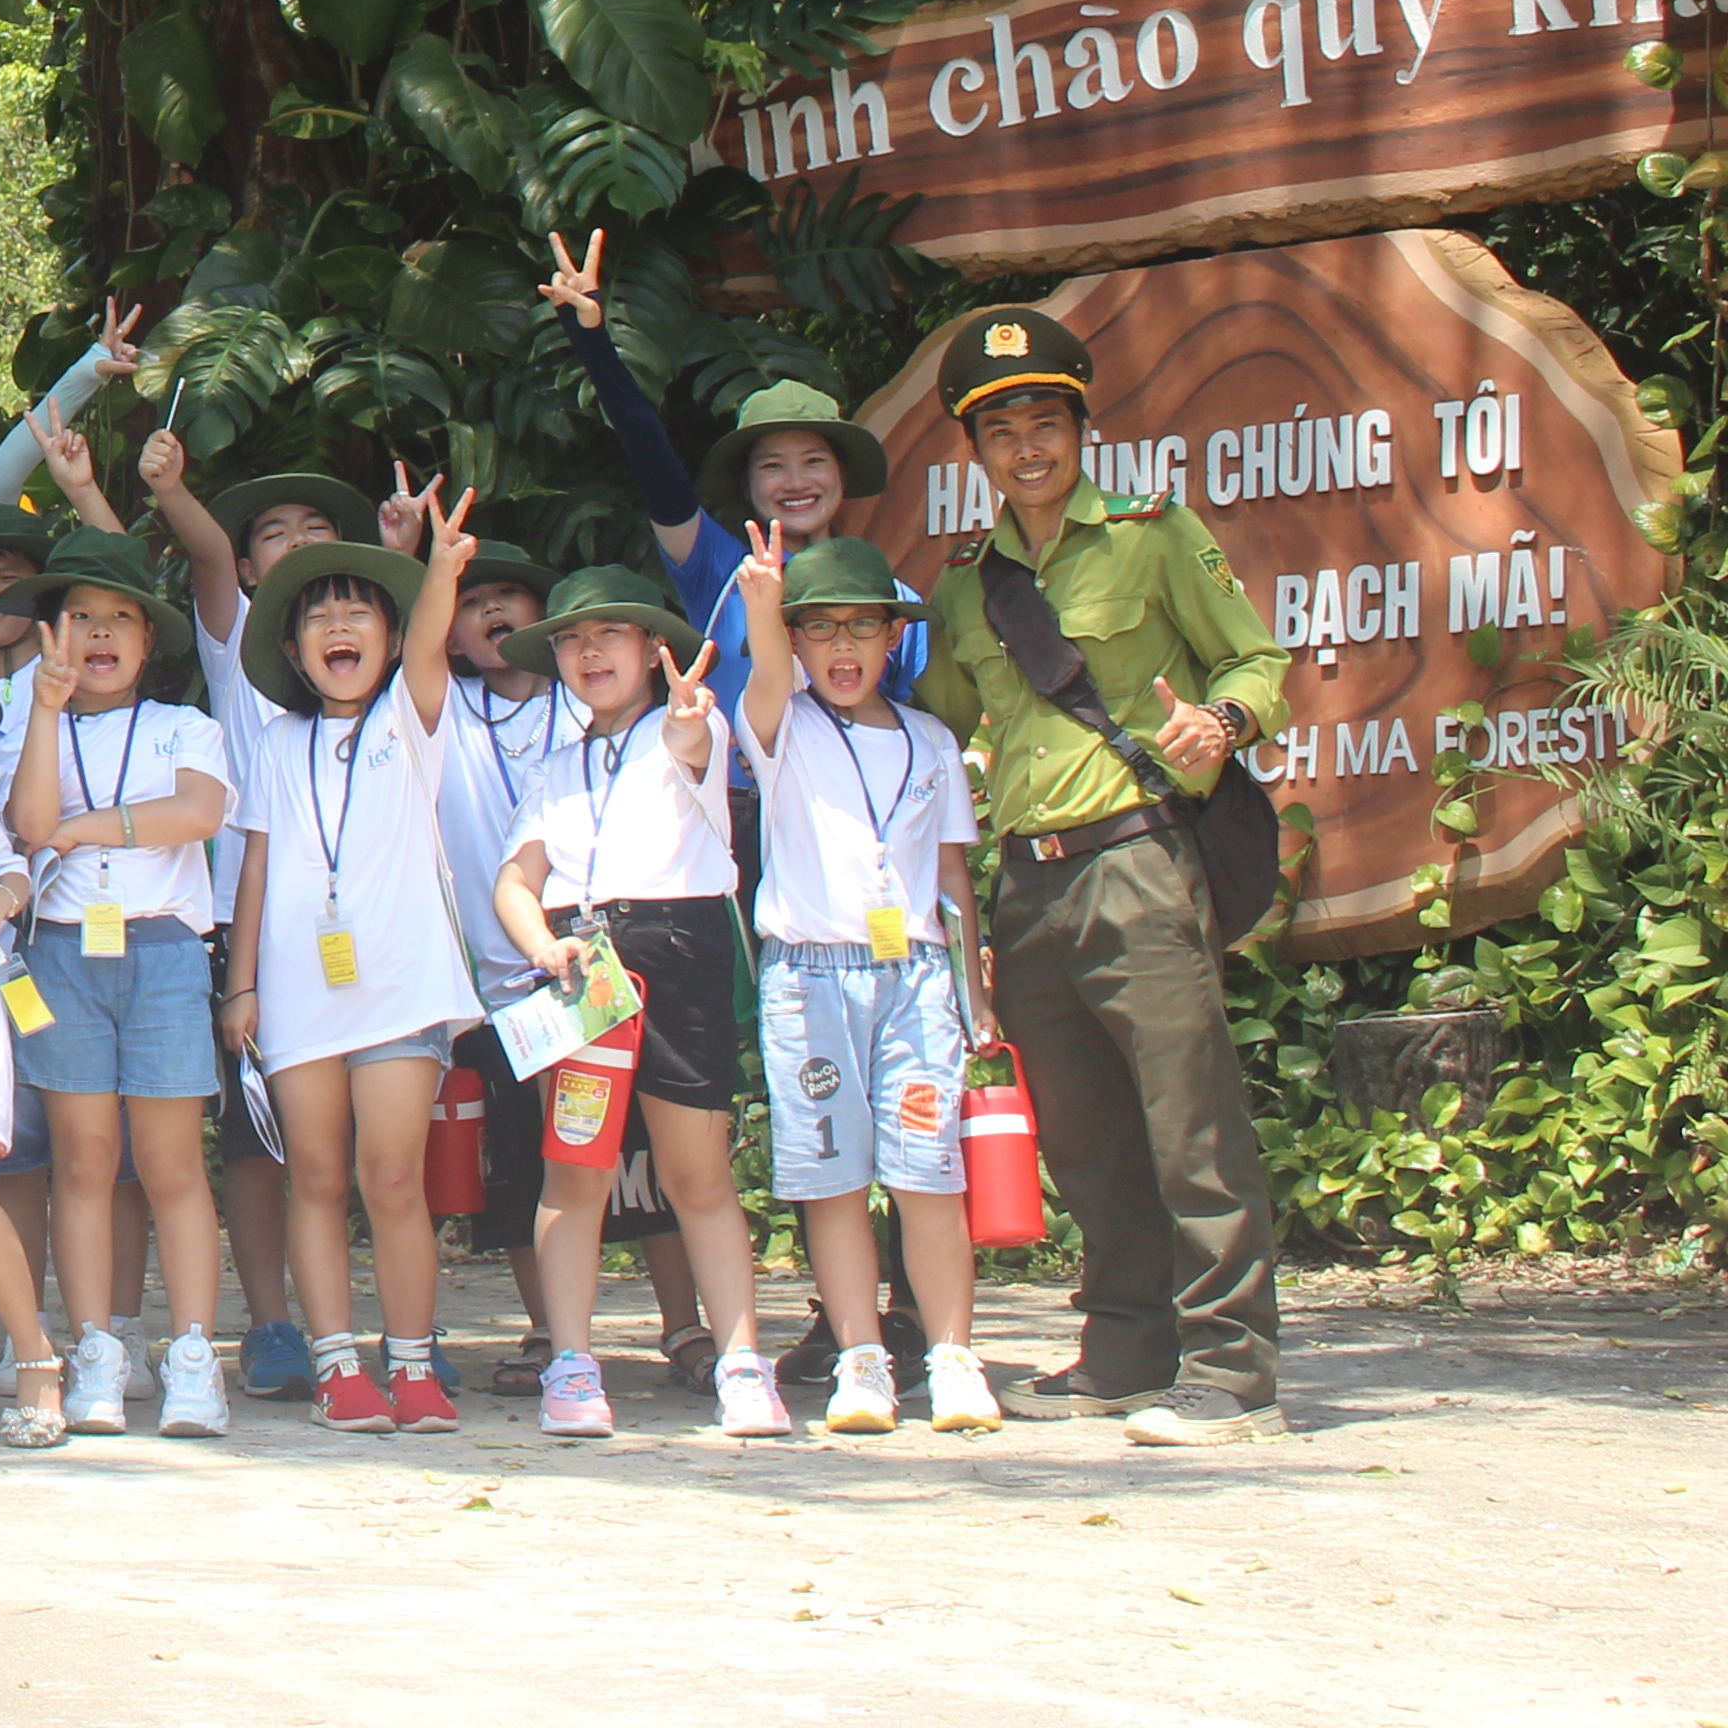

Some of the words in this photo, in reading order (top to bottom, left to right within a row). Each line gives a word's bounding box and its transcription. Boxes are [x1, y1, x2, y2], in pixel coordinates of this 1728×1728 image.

[928, 4, 1200, 139] chào
[1081, 429, 1187, 506] ÙNG
[1206, 402, 1392, 507] CHÚNG
[1434, 379, 1522, 478] TÔI
[1275, 561, 1420, 665] BẠCH
[1449, 529, 1566, 633] MÃ!
[1335, 718, 1418, 777] MA
[1435, 702, 1628, 768] FOREST!
[816, 1115, 840, 1159] 1
